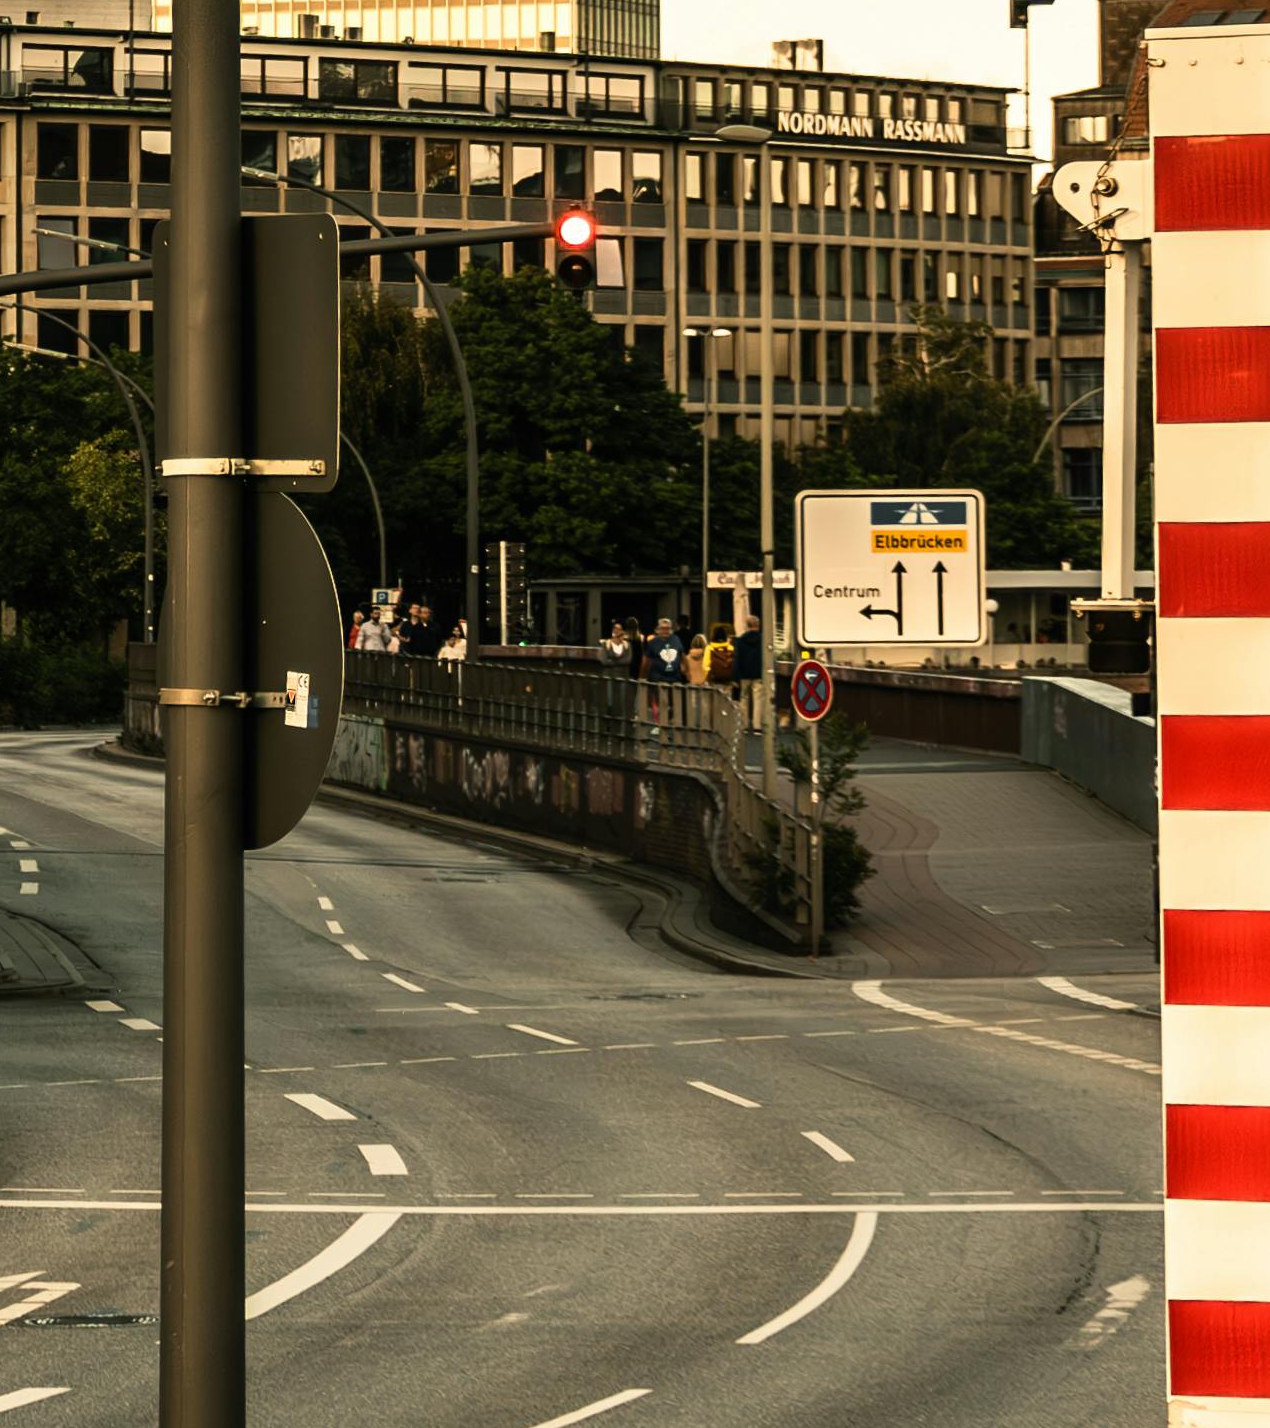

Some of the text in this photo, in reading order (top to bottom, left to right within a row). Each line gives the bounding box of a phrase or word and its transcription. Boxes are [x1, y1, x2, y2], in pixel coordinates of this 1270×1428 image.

[778, 111, 966, 144] NORDMANN RASSMANN
[875, 534, 963, 549] Elbbrücken
[813, 585, 881, 598] Centrum
